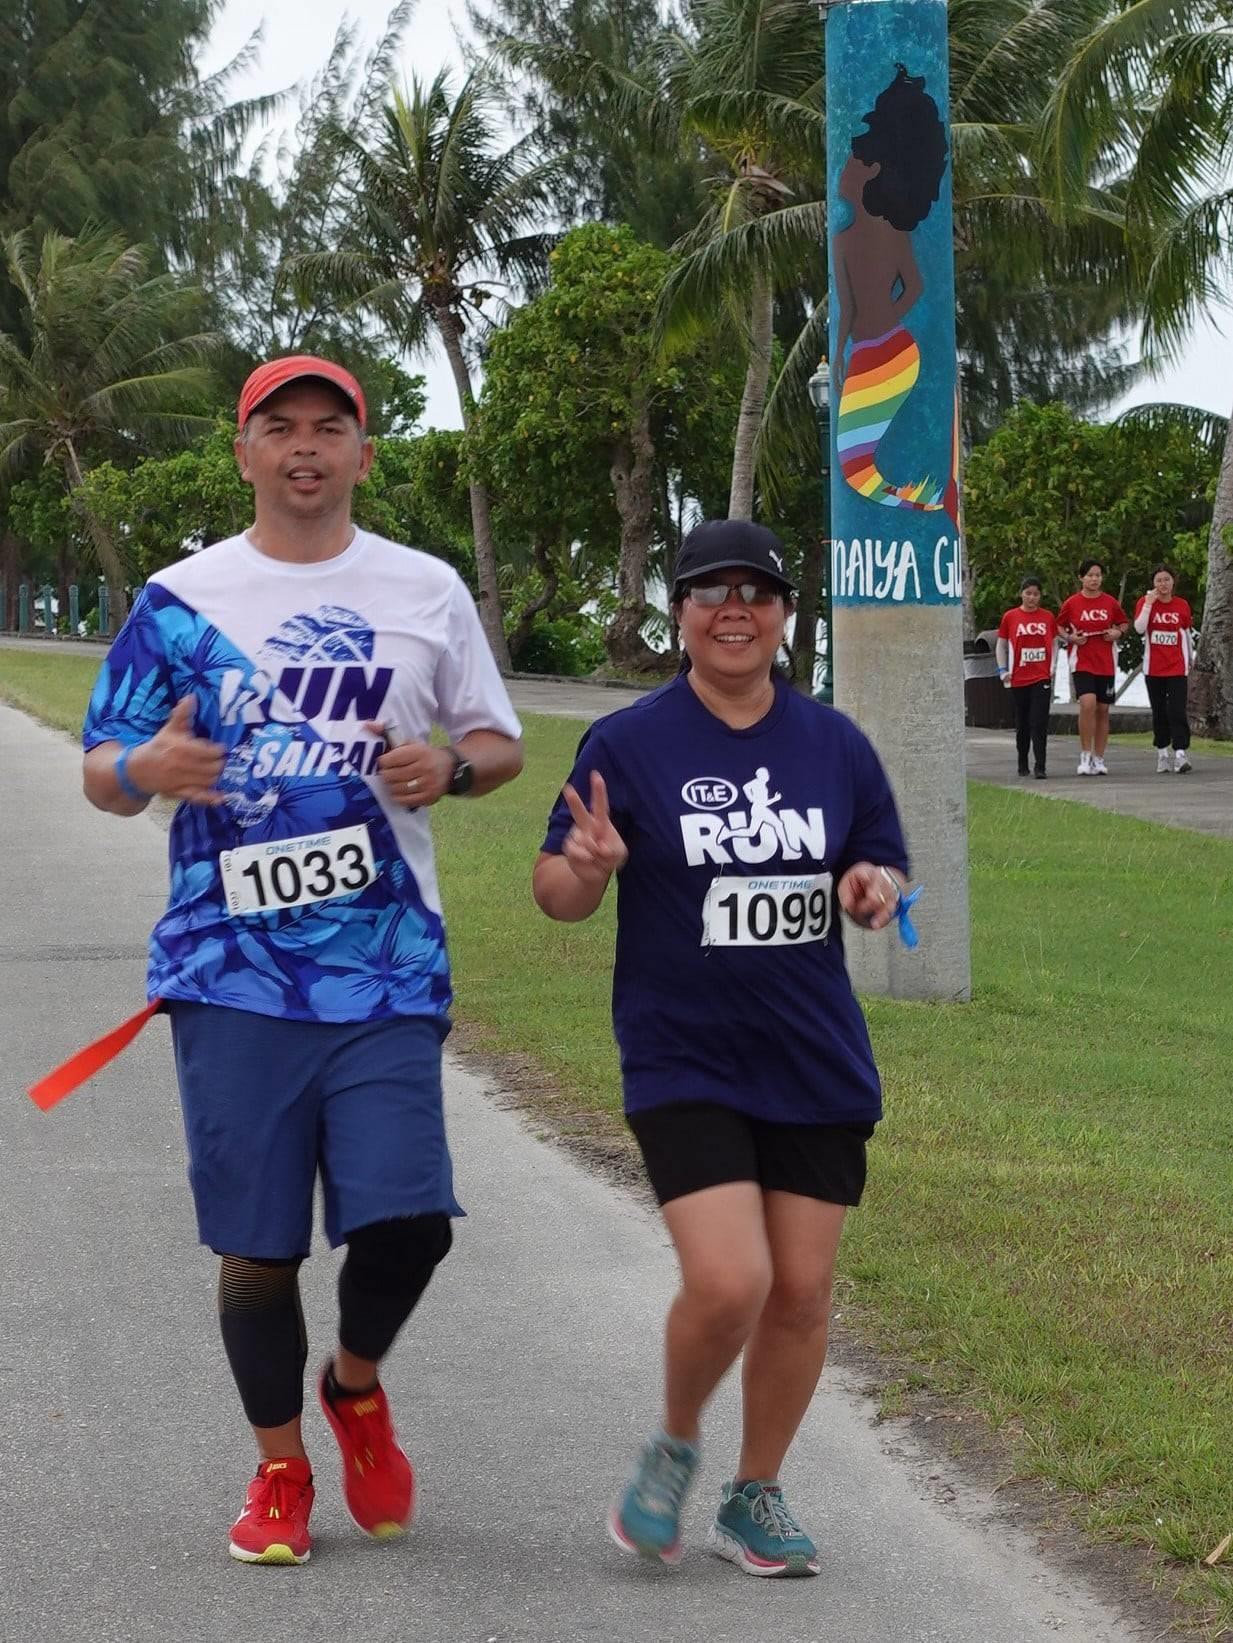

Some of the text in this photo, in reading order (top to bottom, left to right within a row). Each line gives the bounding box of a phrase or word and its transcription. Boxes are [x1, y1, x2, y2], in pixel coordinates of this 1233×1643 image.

[831, 538, 921, 601] NAIYA
[1080, 609, 1108, 621] ACS
[1152, 612, 1179, 624] ACS
[1016, 623, 1046, 637] ACS
[1154, 634, 1177, 645] 1070
[1023, 651, 1045, 661] 1047
[219, 667, 394, 726] RUN
[690, 784, 729, 803] IT&E
[266, 836, 331, 856] ONETIME
[680, 808, 827, 866] RUN
[242, 843, 369, 906] 1033
[747, 879, 812, 891] ONETIME
[718, 888, 827, 941] 1099
